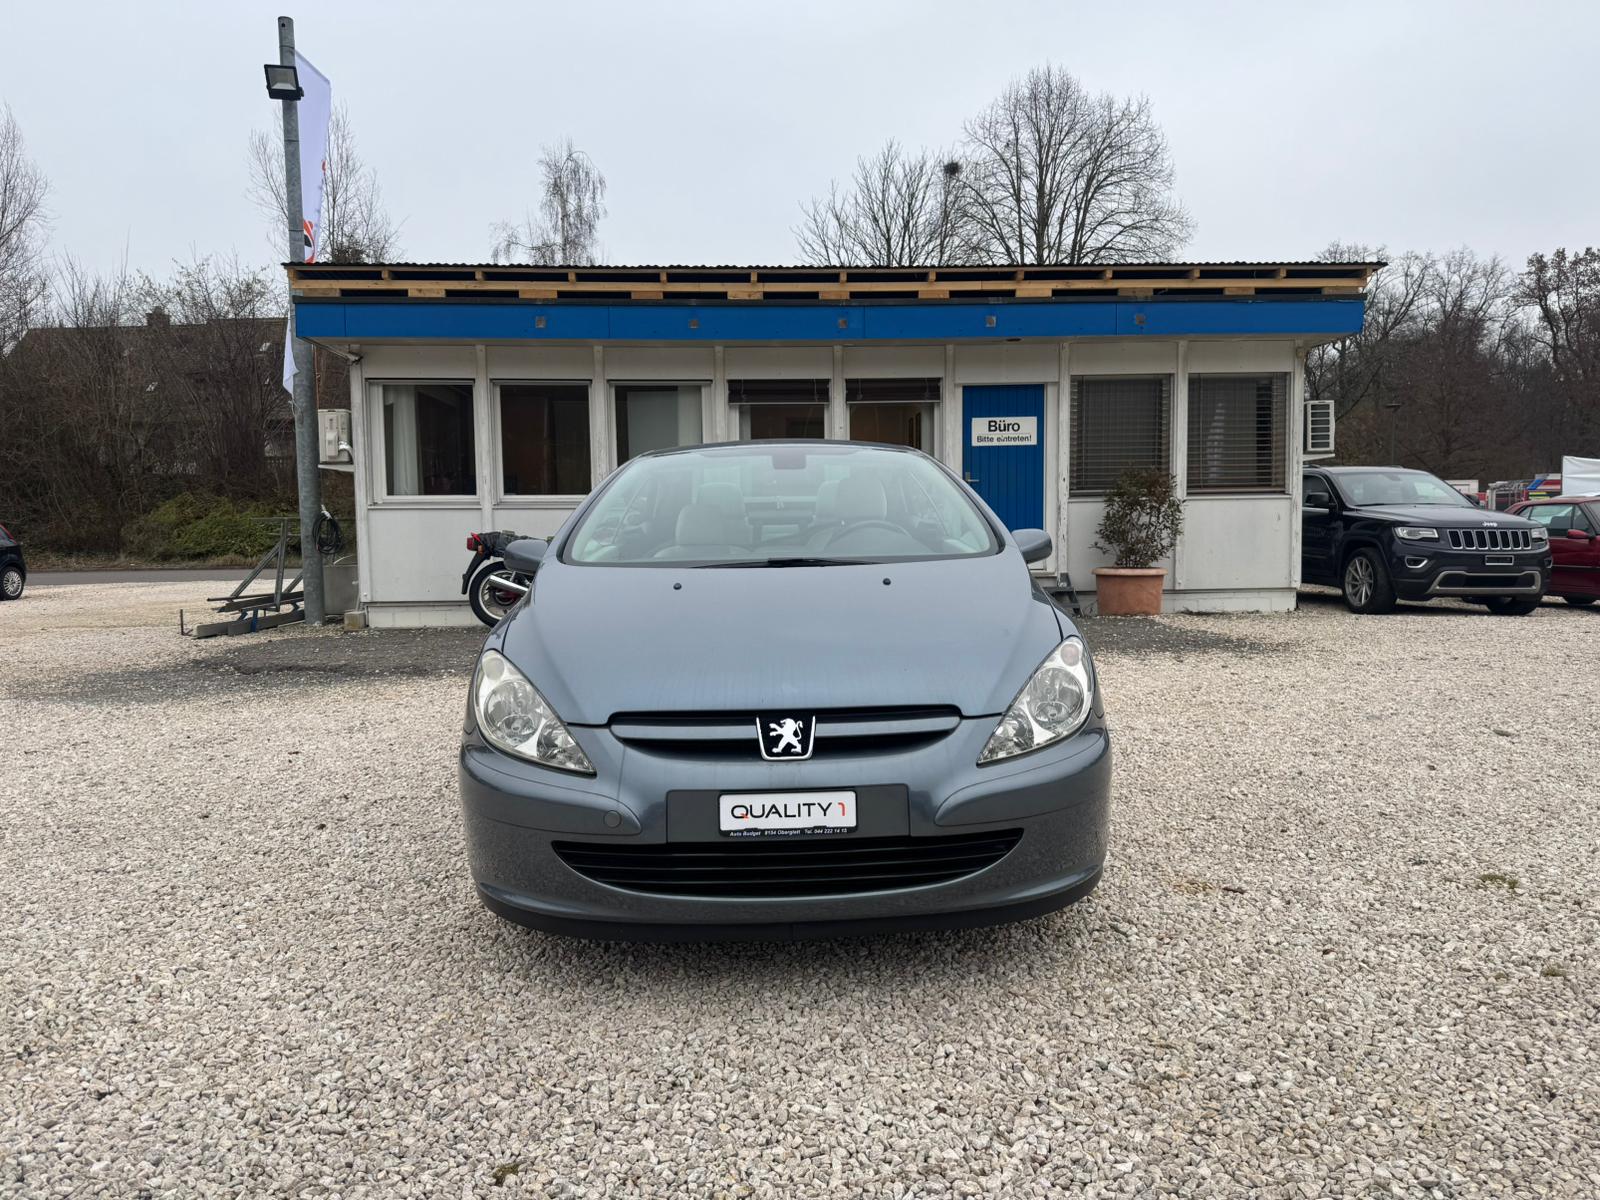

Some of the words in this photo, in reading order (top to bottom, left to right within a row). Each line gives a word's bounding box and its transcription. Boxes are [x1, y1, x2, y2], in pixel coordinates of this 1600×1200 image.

[988, 420, 1020, 432] Büro
[976, 435, 994, 443] Bitte
[996, 434, 1032, 443] eintreten!
[731, 802, 832, 819] QUALITY
[837, 801, 846, 817] 1
